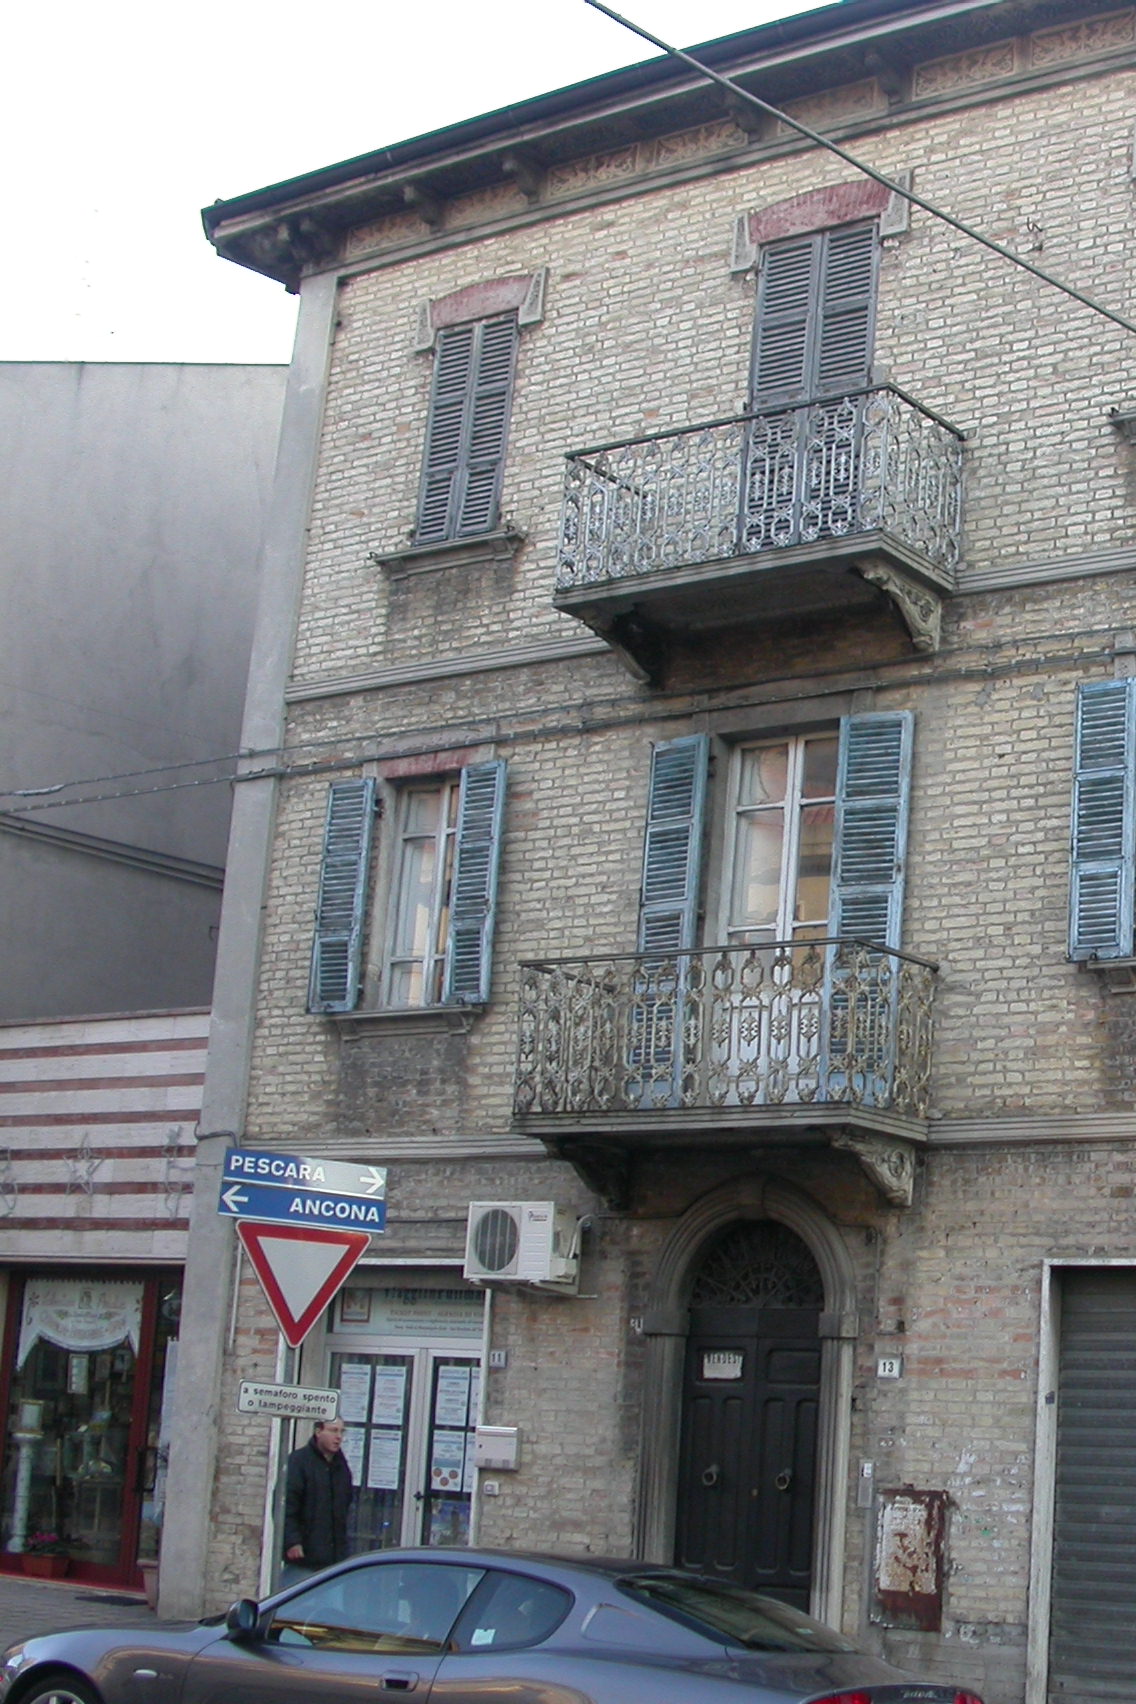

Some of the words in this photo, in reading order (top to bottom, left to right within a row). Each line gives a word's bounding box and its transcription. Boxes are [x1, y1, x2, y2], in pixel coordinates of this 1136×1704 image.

[230, 1155, 326, 1183] PESCARA
[289, 1198, 380, 1223] ANCONA
[491, 1353, 501, 1362] 11
[881, 1361, 895, 1373] 13
[253, 1388, 298, 1399] semaforo
[303, 1394, 336, 1404] spento
[259, 1400, 327, 1415] lampeggiante
